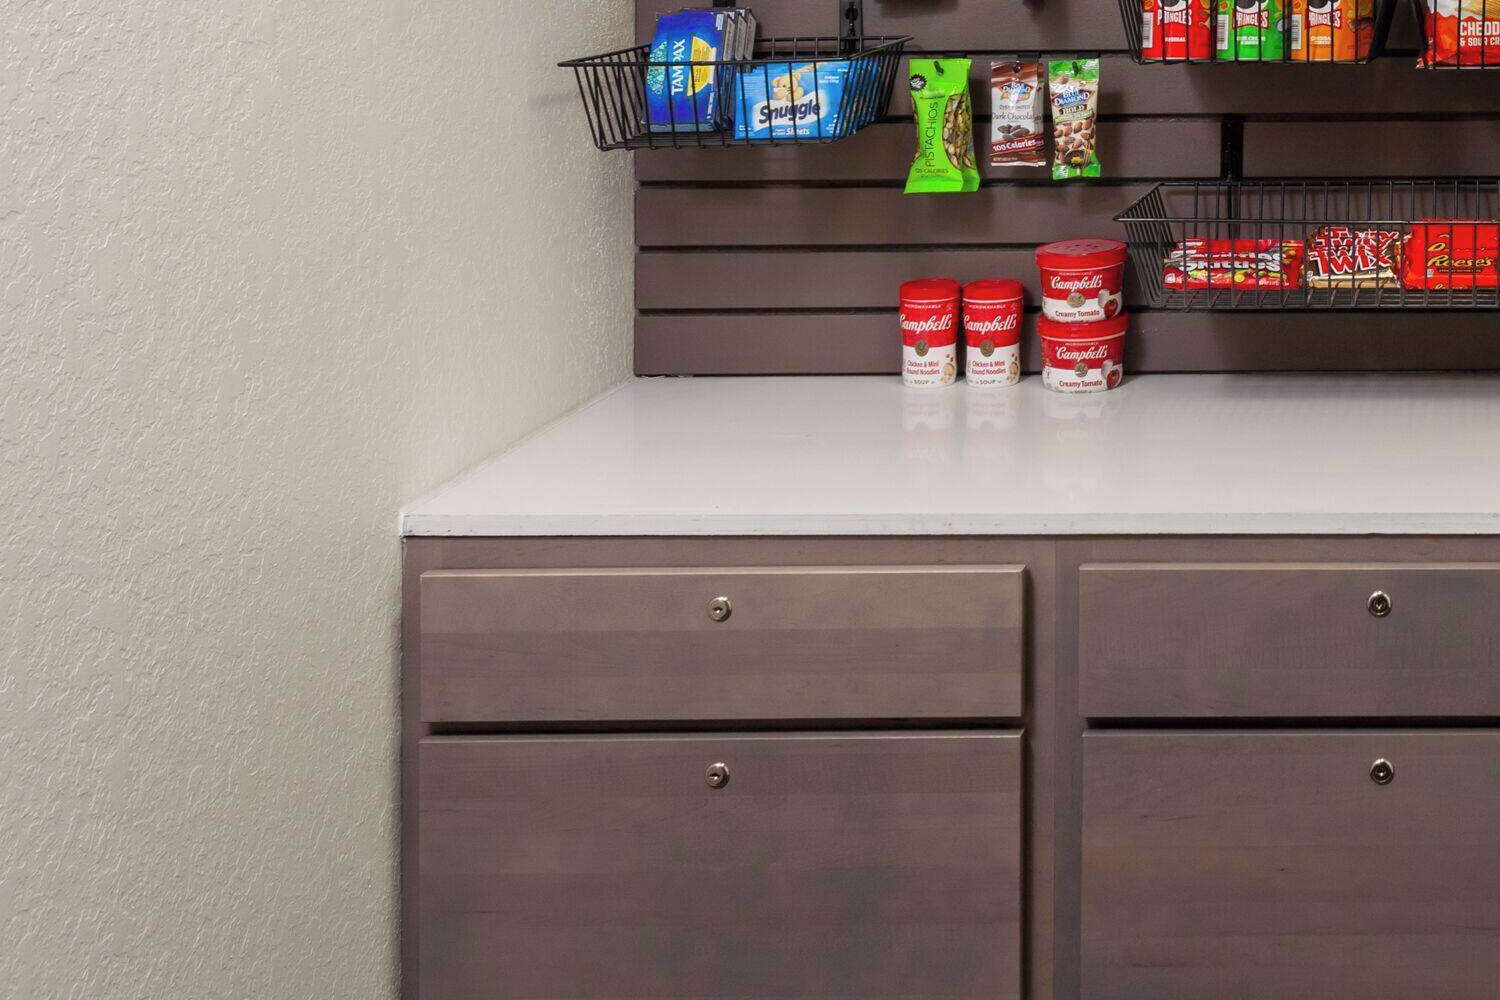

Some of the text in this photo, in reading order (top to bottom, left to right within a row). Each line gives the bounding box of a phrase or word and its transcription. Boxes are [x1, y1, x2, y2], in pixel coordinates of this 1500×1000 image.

[1459, 38, 1467, 47] &
[1054, 93, 1090, 105] DIAMOND
[925, 101, 939, 167] PISTACHIOS
[1006, 139, 1037, 150] Calories
[1051, 275, 1103, 291] Campbell's
[899, 313, 953, 335] Campbell's
[962, 313, 1018, 335] Campbell's
[1055, 345, 1109, 362] Campbell's
[1059, 380, 1081, 389] Creamy
